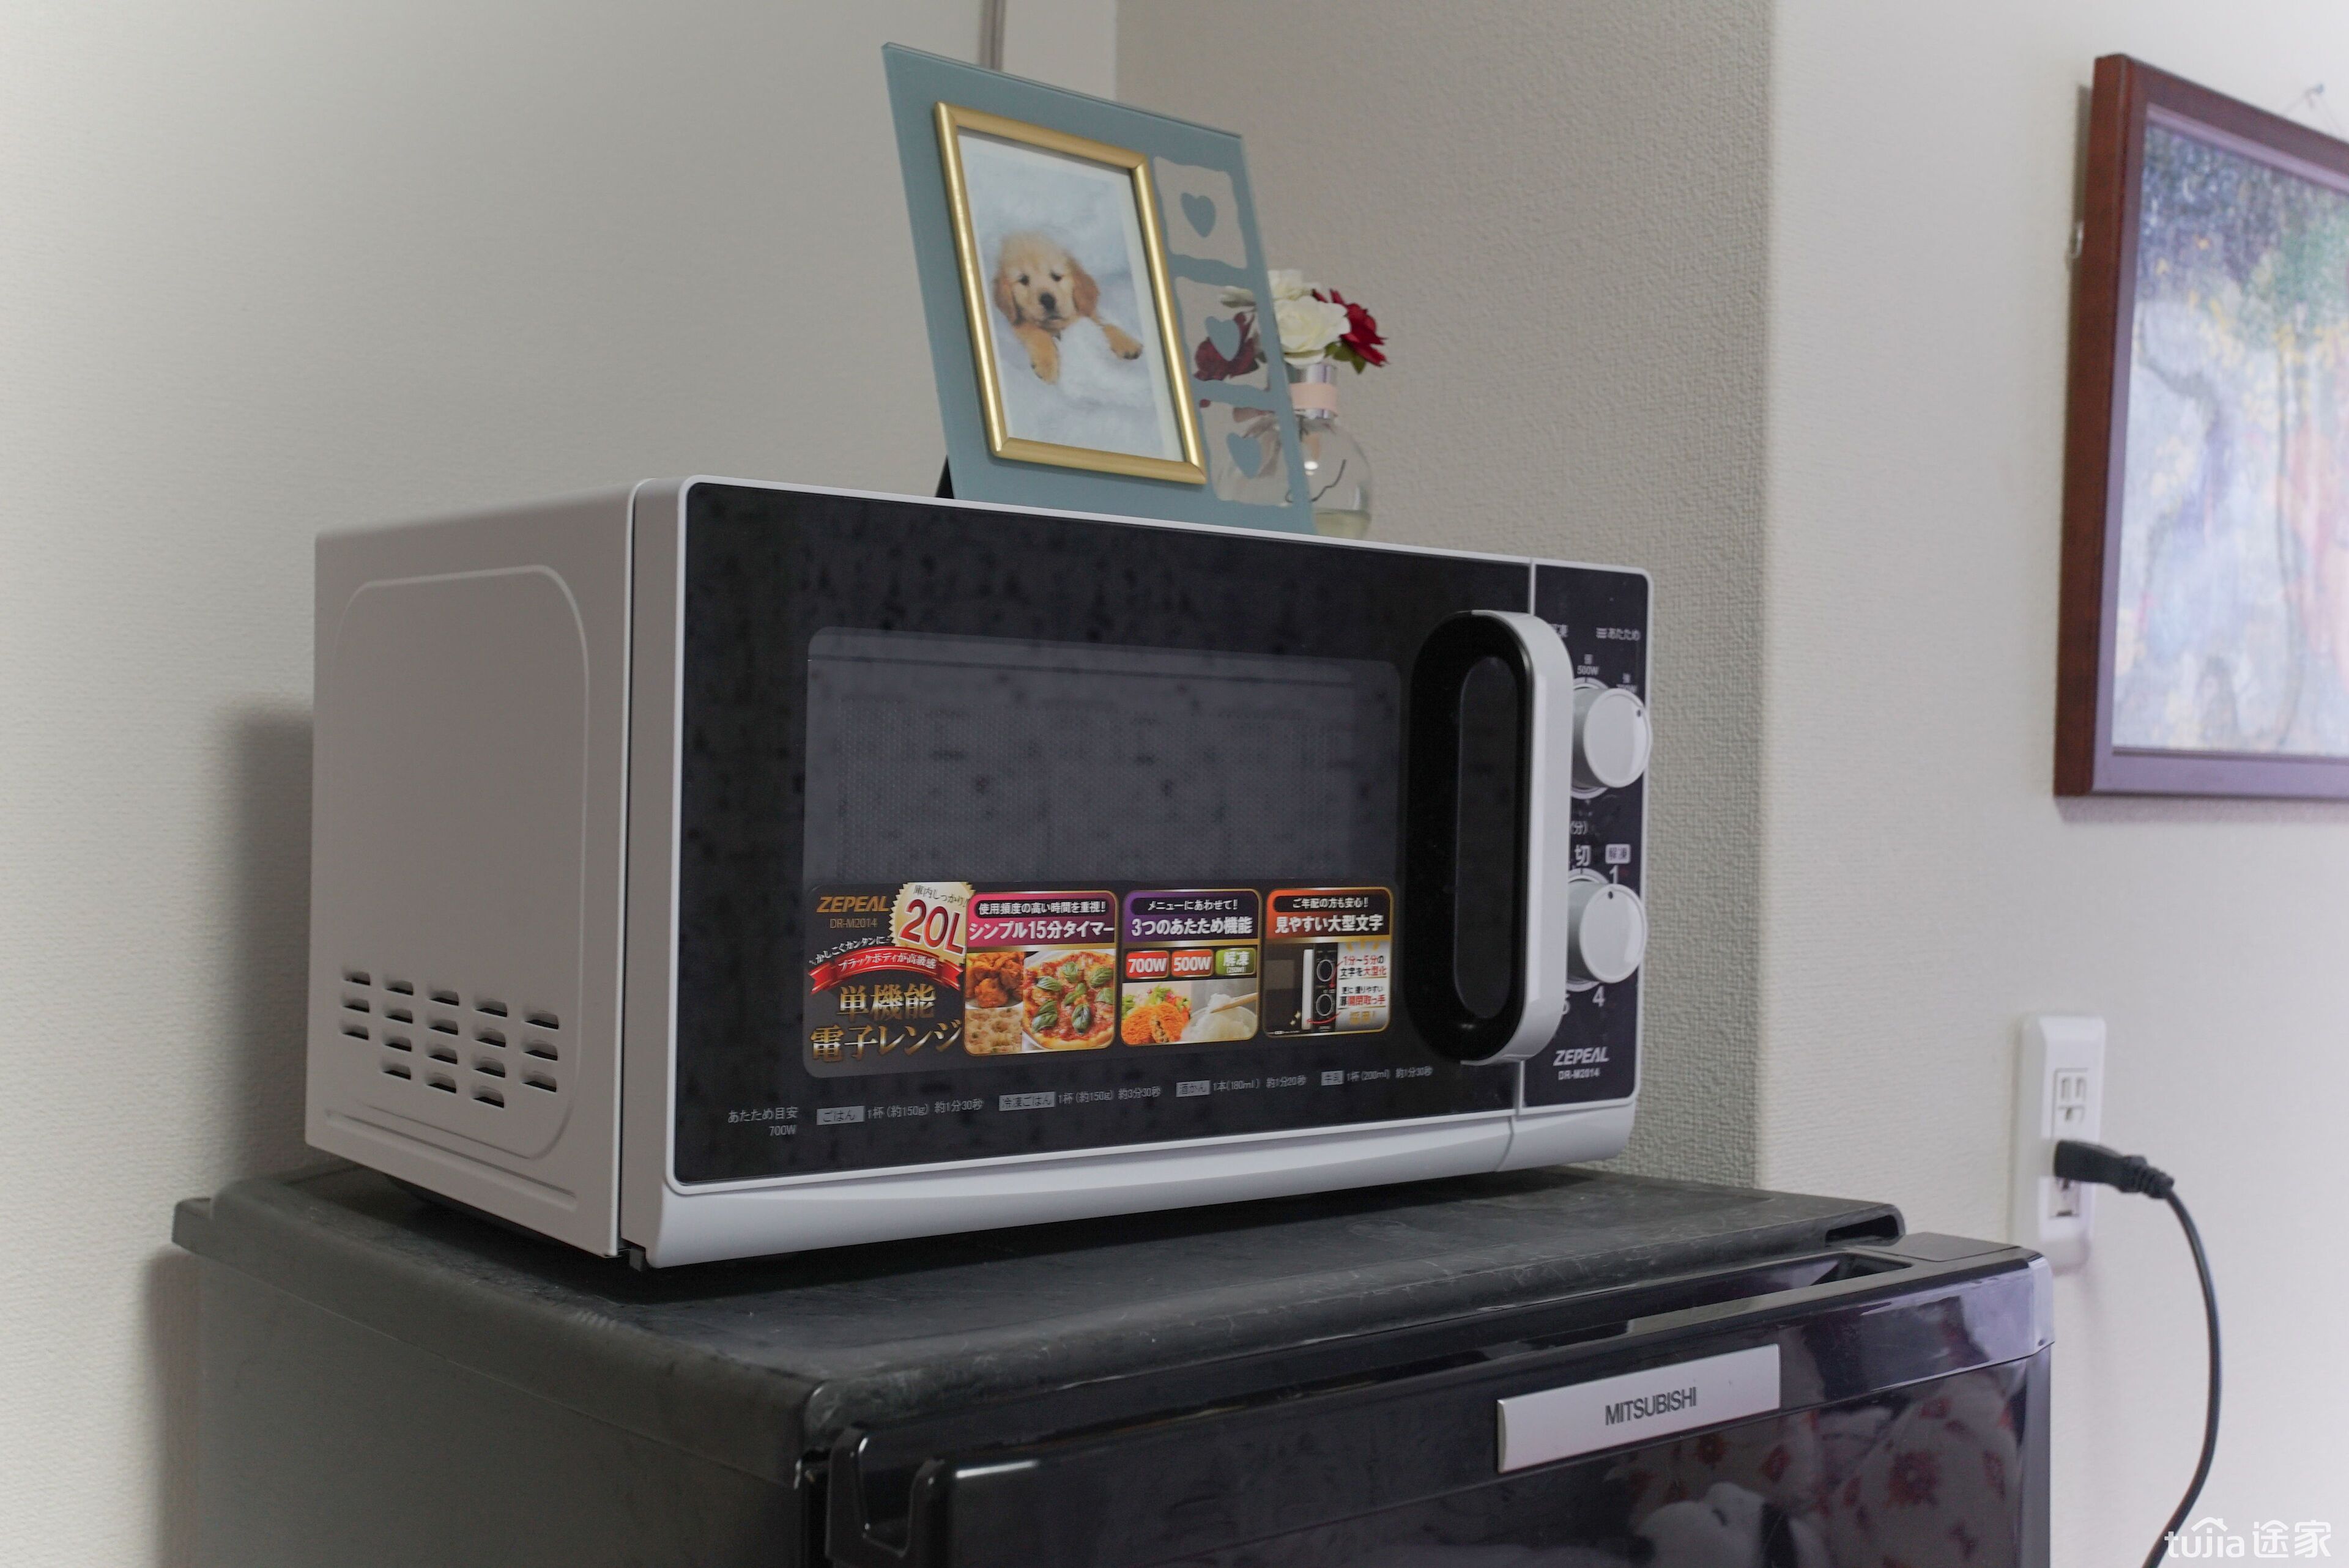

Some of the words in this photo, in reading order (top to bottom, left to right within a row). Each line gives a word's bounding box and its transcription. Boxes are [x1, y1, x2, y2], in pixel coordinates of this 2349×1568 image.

[1577, 665, 1599, 675] 500W
[1575, 845, 1591, 866] 切
[817, 896, 890, 912] ZEPEAL
[1147, 899, 1238, 911] メニューにあわせて!
[1293, 897, 1369, 909] ご年配の方も安心!
[830, 918, 877, 929] DR-M2014
[898, 898, 967, 956] 20L
[969, 920, 1115, 940] シンプル15分タイマー
[1131, 916, 1253, 936] 3つのあたため機能
[1275, 915, 1384, 934] 見やすい大型文字
[1128, 957, 1167, 973] 700W
[1173, 956, 1212, 971] 500W
[1223, 952, 1249, 966] 解凍
[839, 983, 936, 1020] 単機能
[1592, 986, 1605, 1007] 4
[810, 1019, 962, 1062] 電子レンジ
[1553, 1046, 1609, 1066] ZEPEAL
[1558, 1068, 1600, 1080] DR-M2014
[728, 1106, 798, 1123] あたため目安
[822, 1109, 855, 1122] ごはん
[769, 1124, 796, 1136] 700W
[1605, 1387, 1697, 1425] MITSUBISHI
